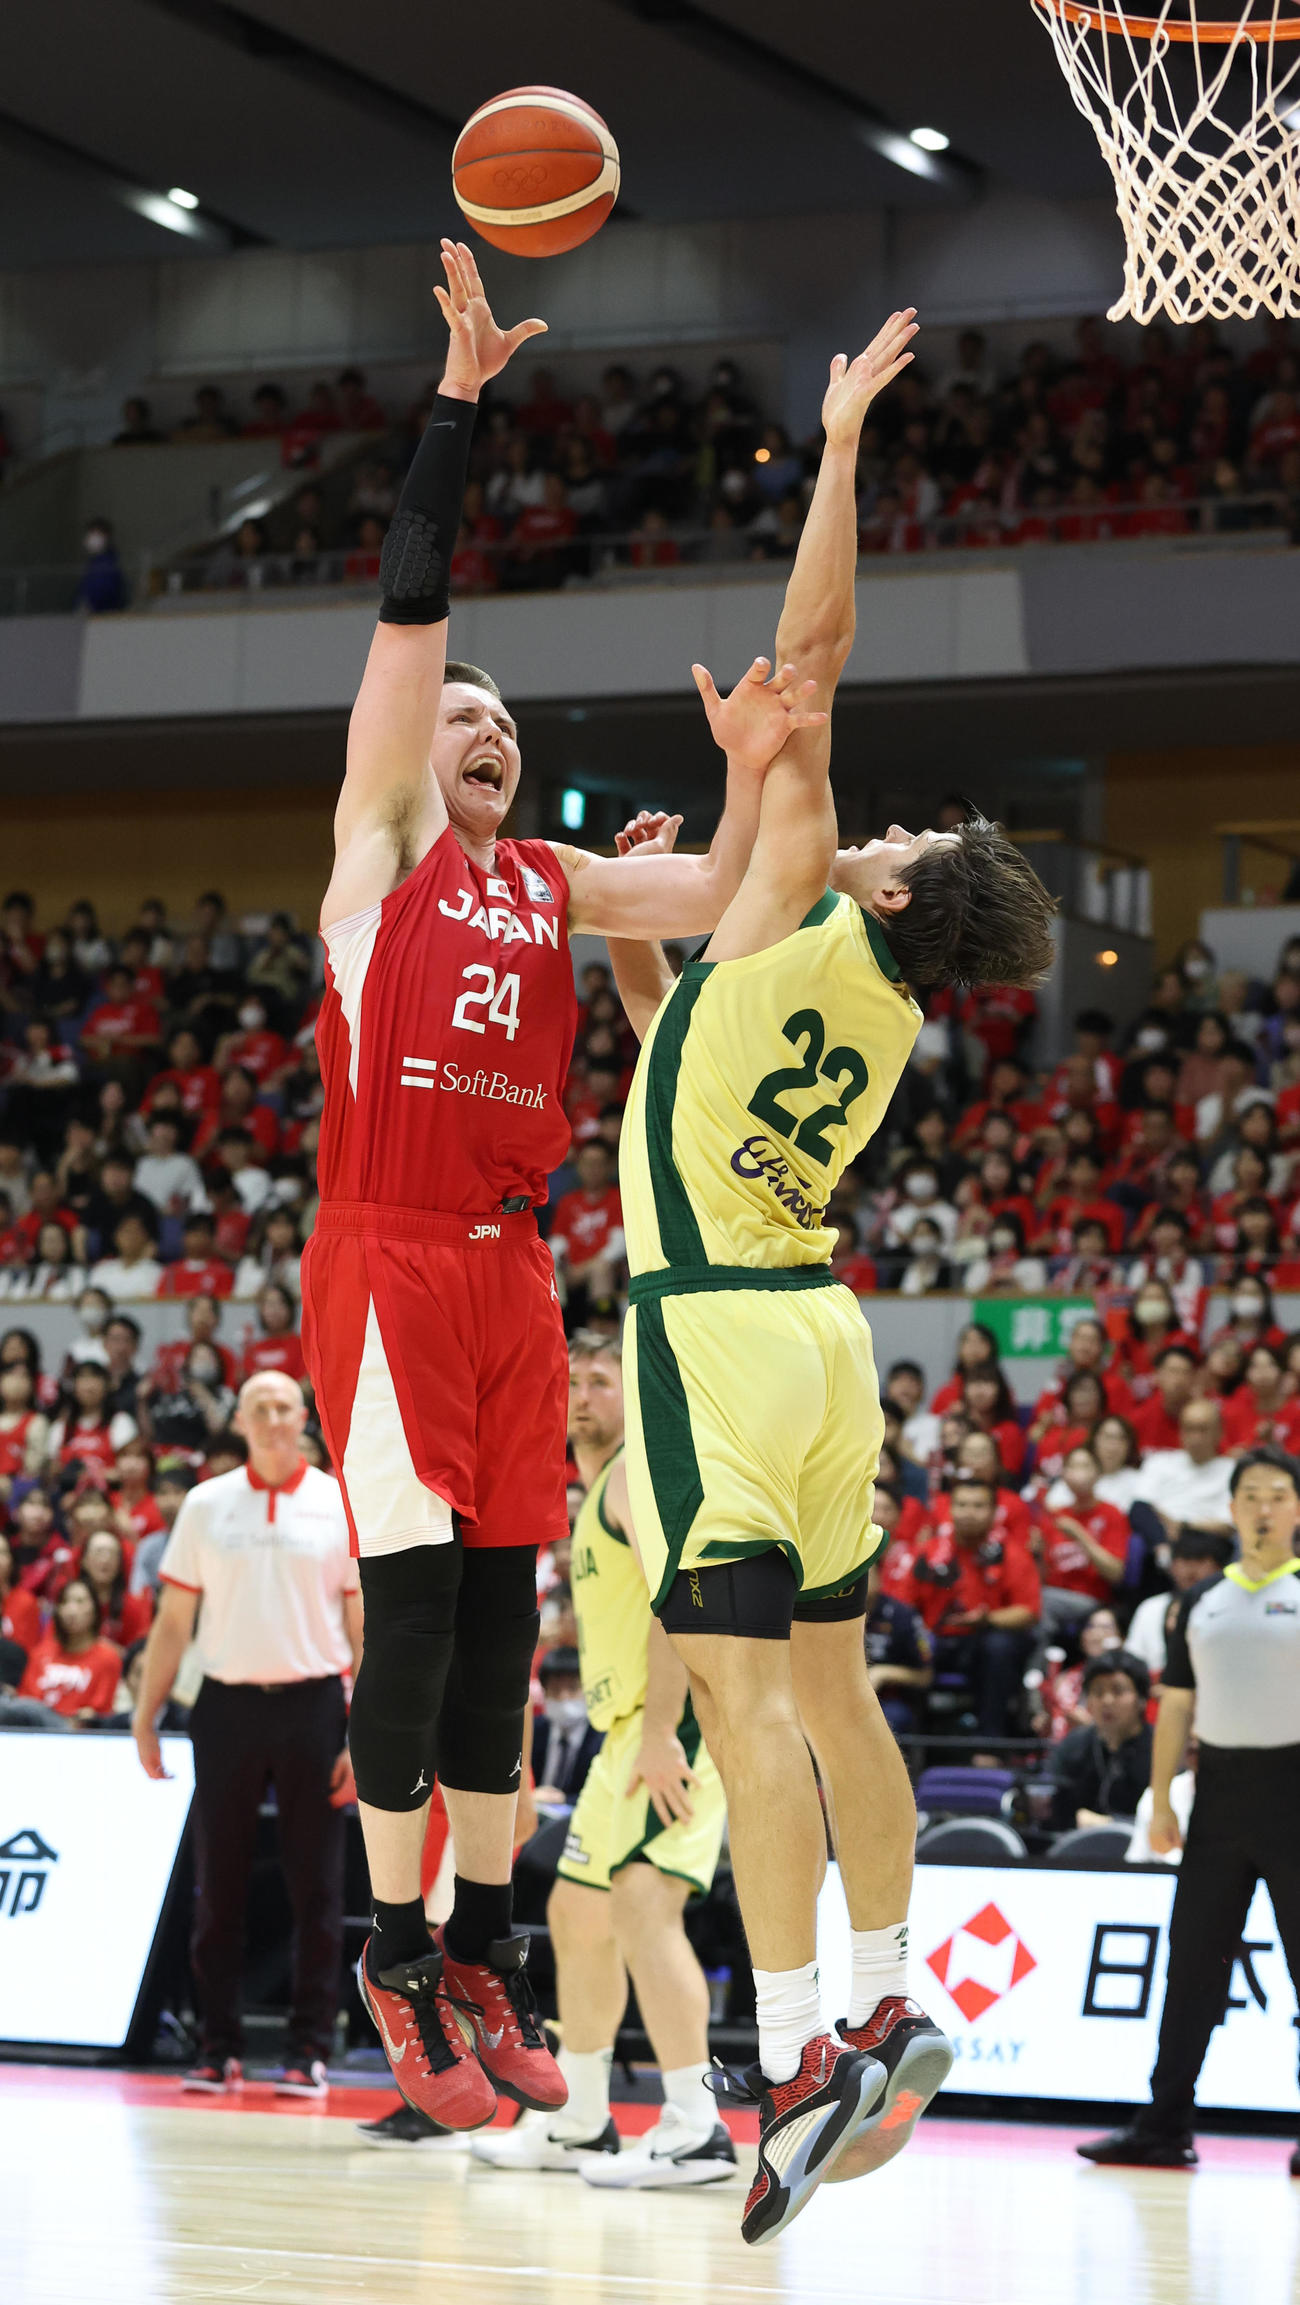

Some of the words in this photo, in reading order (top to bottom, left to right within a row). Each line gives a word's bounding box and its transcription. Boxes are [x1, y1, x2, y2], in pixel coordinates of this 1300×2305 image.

[437, 888, 559, 951] JAPAN
[451, 963, 521, 1041] 24
[440, 1062, 549, 1109] SoftBank
[748, 1009, 869, 1167] 22
[469, 1224, 501, 1240] JPN
[953, 2037, 1025, 2063] SSAY
